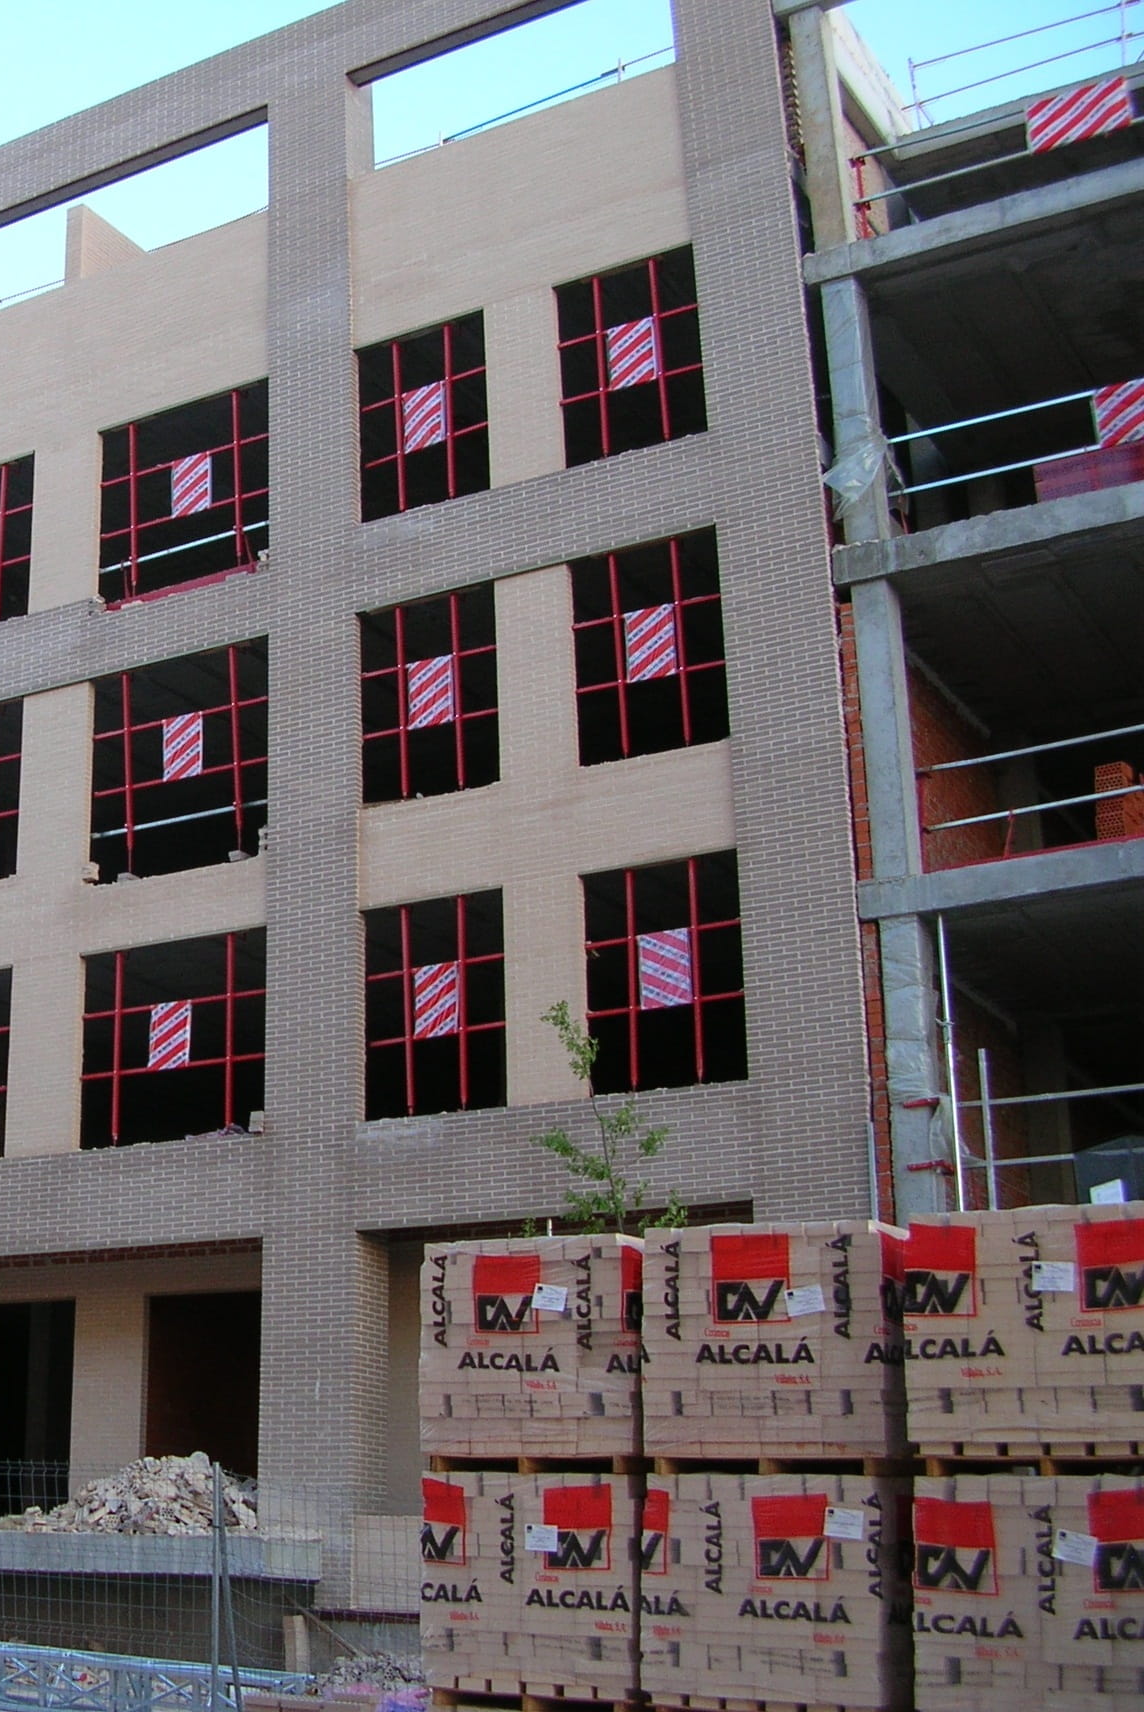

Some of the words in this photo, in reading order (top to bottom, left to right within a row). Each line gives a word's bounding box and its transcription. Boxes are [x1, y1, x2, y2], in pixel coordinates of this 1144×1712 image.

[429, 1255, 448, 1347] ALCALÁ
[571, 1253, 592, 1350] ALCALÁ
[660, 1241, 681, 1341] ALCALÁ
[825, 1234, 852, 1340] ALCALÁ
[458, 1347, 560, 1373] ALCALÁ
[696, 1336, 814, 1364] ALCALÁ
[495, 1493, 515, 1584] ALCALÁ
[699, 1501, 723, 1594] ALCALÁ
[861, 1492, 883, 1600] ALCALÁ
[1028, 1504, 1056, 1615] ALCALÁ
[526, 1585, 630, 1612] ALCALÁ
[738, 1596, 851, 1624] ALCALÁ
